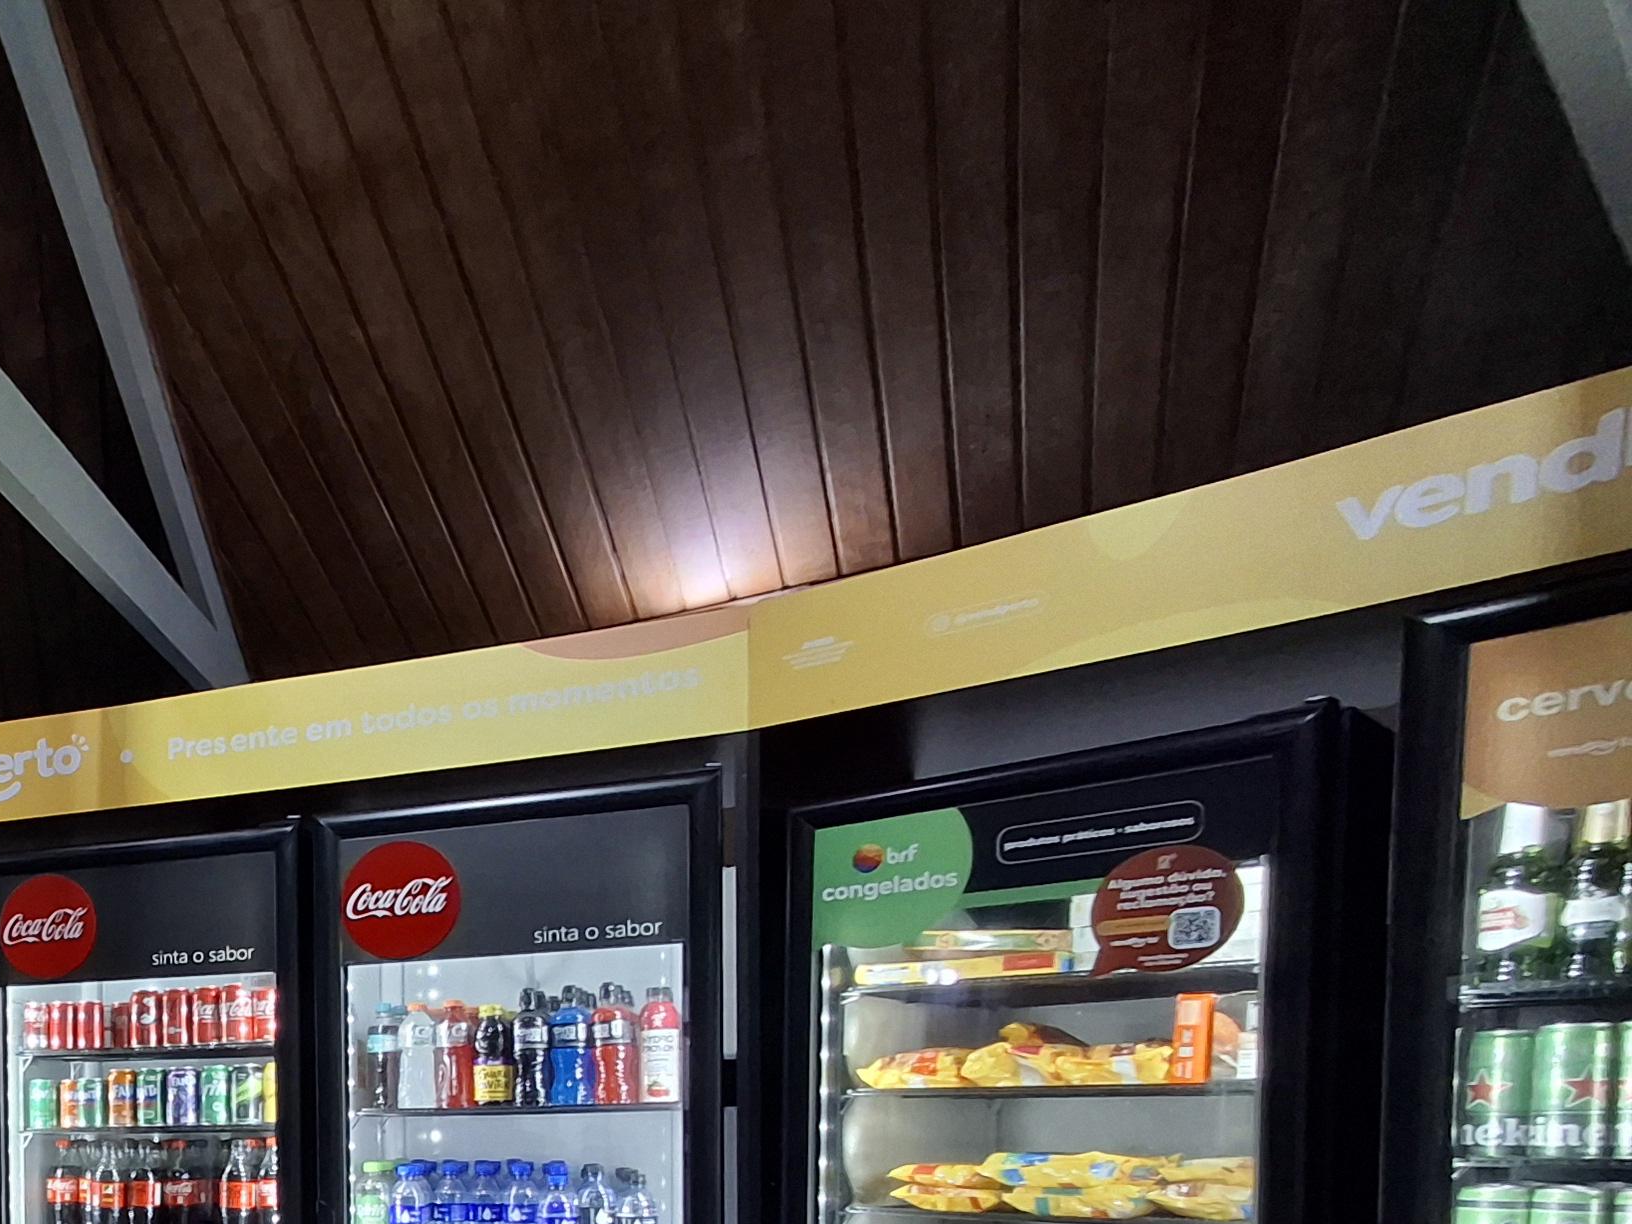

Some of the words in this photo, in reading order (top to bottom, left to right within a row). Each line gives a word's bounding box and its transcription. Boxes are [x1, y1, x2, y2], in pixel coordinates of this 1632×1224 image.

[167, 726, 297, 761] Presente
[305, 718, 352, 742] em
[361, 703, 453, 736] todos
[462, 697, 498, 721] os
[507, 667, 702, 715] momentos
[1496, 678, 1632, 722] cerv
[887, 844, 920, 865] brf
[346, 876, 453, 920] Coca-Cola
[822, 871, 959, 901] congelados
[3, 906, 88, 945] Coca-Cola
[533, 925, 579, 944] sinta
[584, 925, 599, 939] o
[604, 919, 663, 938] sabor
[151, 950, 188, 966] sinta
[192, 950, 204, 963] o
[208, 945, 255, 962] sabor
